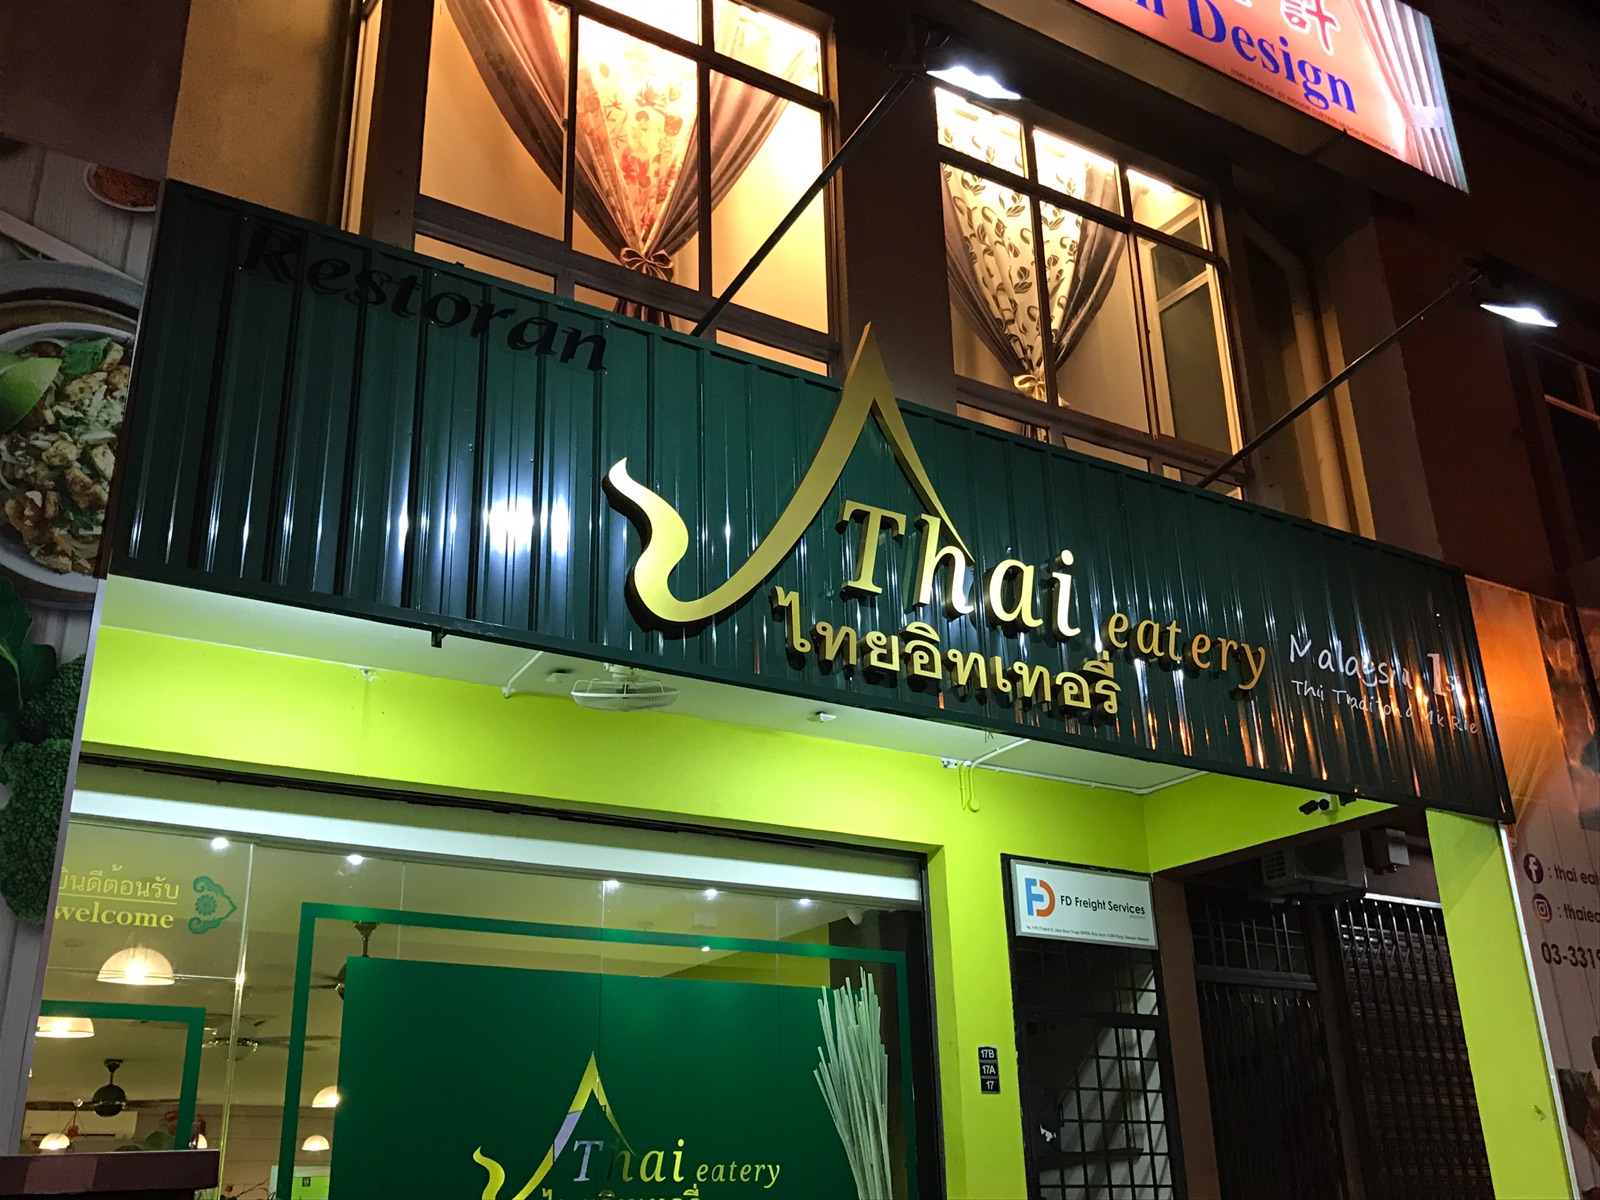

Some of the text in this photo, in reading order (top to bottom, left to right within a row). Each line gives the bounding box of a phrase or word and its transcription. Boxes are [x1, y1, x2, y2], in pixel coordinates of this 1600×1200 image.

[1187, 0, 1357, 114] Design
[243, 225, 608, 371] Restoran
[836, 500, 1266, 690] Thai eatery
[771, 586, 1121, 715] ไทยอิทเทอรี่
[1427, 653, 1461, 697] 1s
[1554, 864, 1578, 883] thai
[55, 901, 174, 929] welcome
[1060, 895, 1146, 915] FD Freight Services
[980, 1049, 995, 1059] 17B
[982, 1065, 996, 1075] 17A
[986, 1080, 995, 1090] 17
[573, 1138, 781, 1189] Thai eatery
